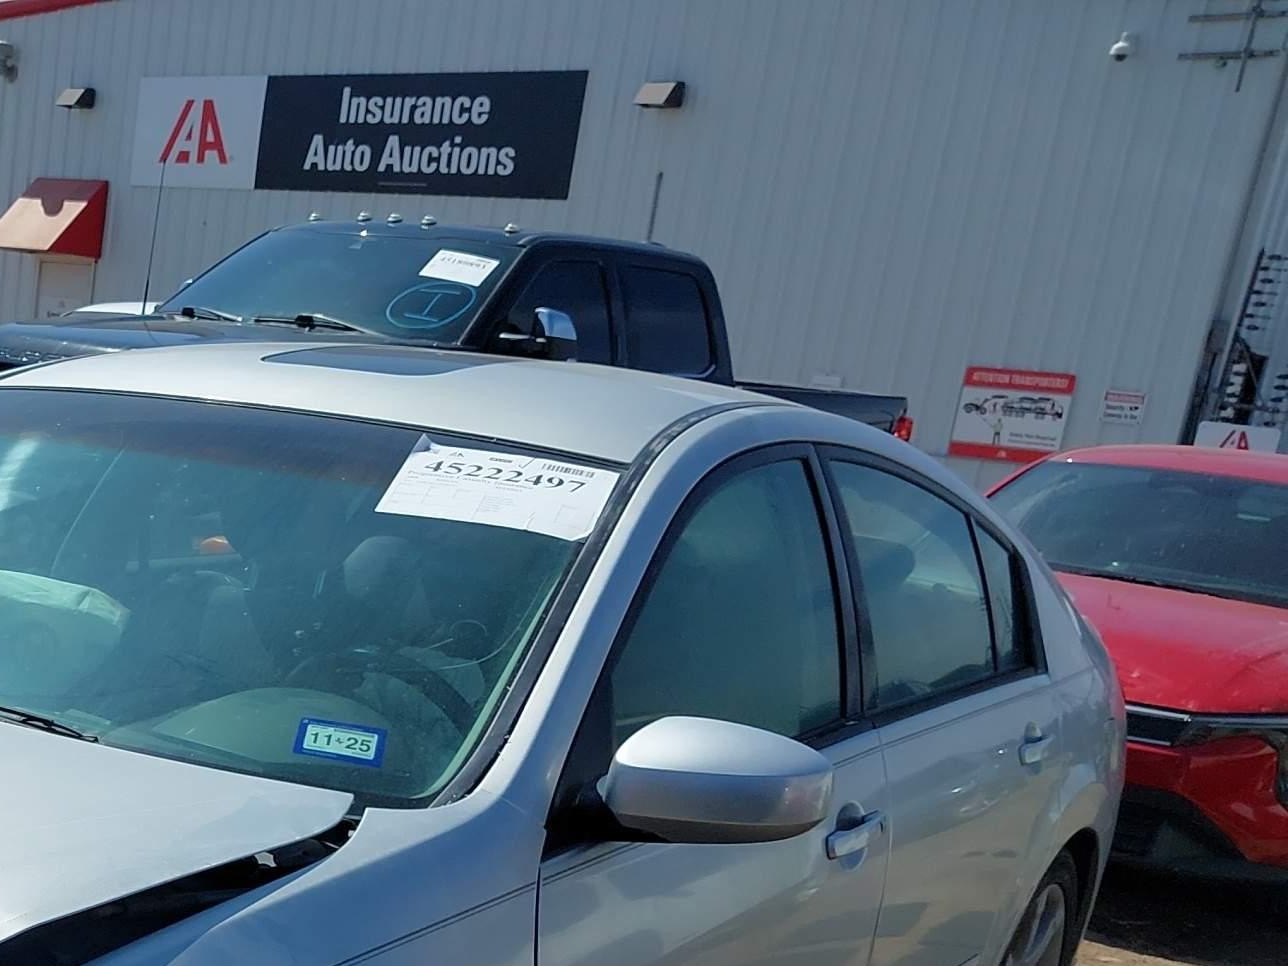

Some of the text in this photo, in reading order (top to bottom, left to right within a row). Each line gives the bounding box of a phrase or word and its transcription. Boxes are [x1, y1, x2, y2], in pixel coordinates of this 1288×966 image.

[339, 86, 491, 125] Insurance
[303, 134, 516, 176] Auto Auctions
[424, 460, 586, 493] 45222497
